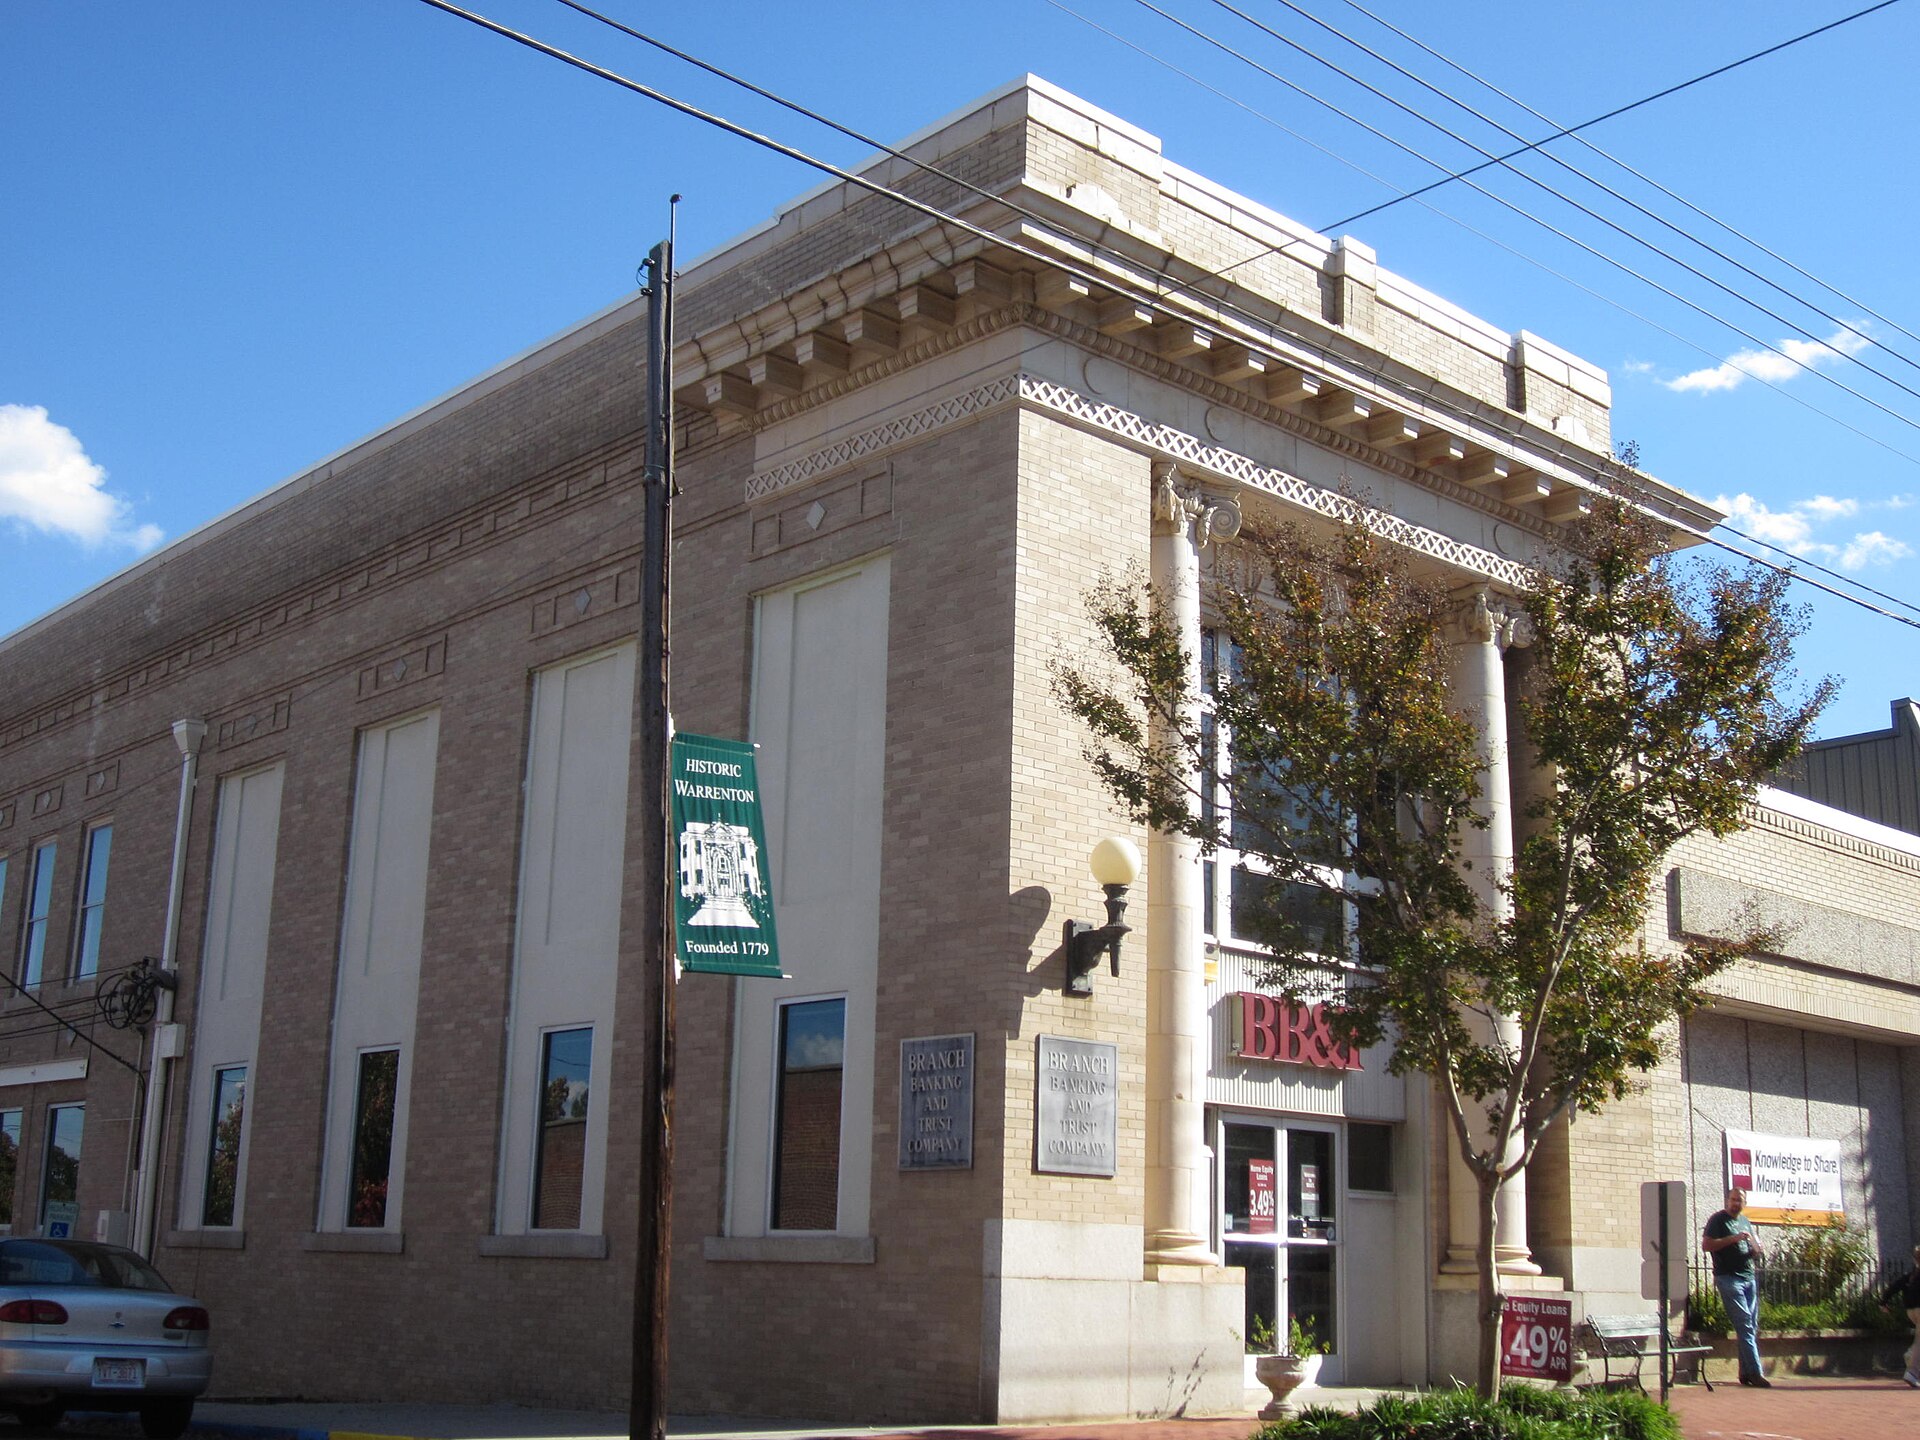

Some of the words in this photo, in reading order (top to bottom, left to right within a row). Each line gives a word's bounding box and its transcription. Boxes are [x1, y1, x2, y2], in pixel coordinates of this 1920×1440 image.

[686, 758, 742, 778] HISTORIC
[674, 779, 755, 803] WARRENTON
[685, 940, 738, 954] Founded
[742, 941, 769, 956] 1779
[908, 1050, 965, 1072] BRANCH
[1048, 1051, 1109, 1075] BRANCH
[910, 1076, 962, 1092] BANKING
[1050, 1076, 1106, 1095] BANKING
[924, 1096, 948, 1111] AND
[1067, 1099, 1092, 1114] AND
[919, 1116, 952, 1132] TRUST
[1060, 1119, 1097, 1135] TRUST
[907, 1138, 961, 1153] COMPANY
[1048, 1139, 1106, 1157] COMPANY
[1755, 1150, 1802, 1174] Knowledge
[1804, 1156, 1812, 1171] to
[1756, 1174, 1786, 1198] Money
[1787, 1178, 1796, 1194] to
[1798, 1177, 1820, 1196] Lend.
[1512, 1301, 1540, 1315] Equity
[1541, 1303, 1568, 1315] Loans
[1550, 1357, 1567, 1370] APR
